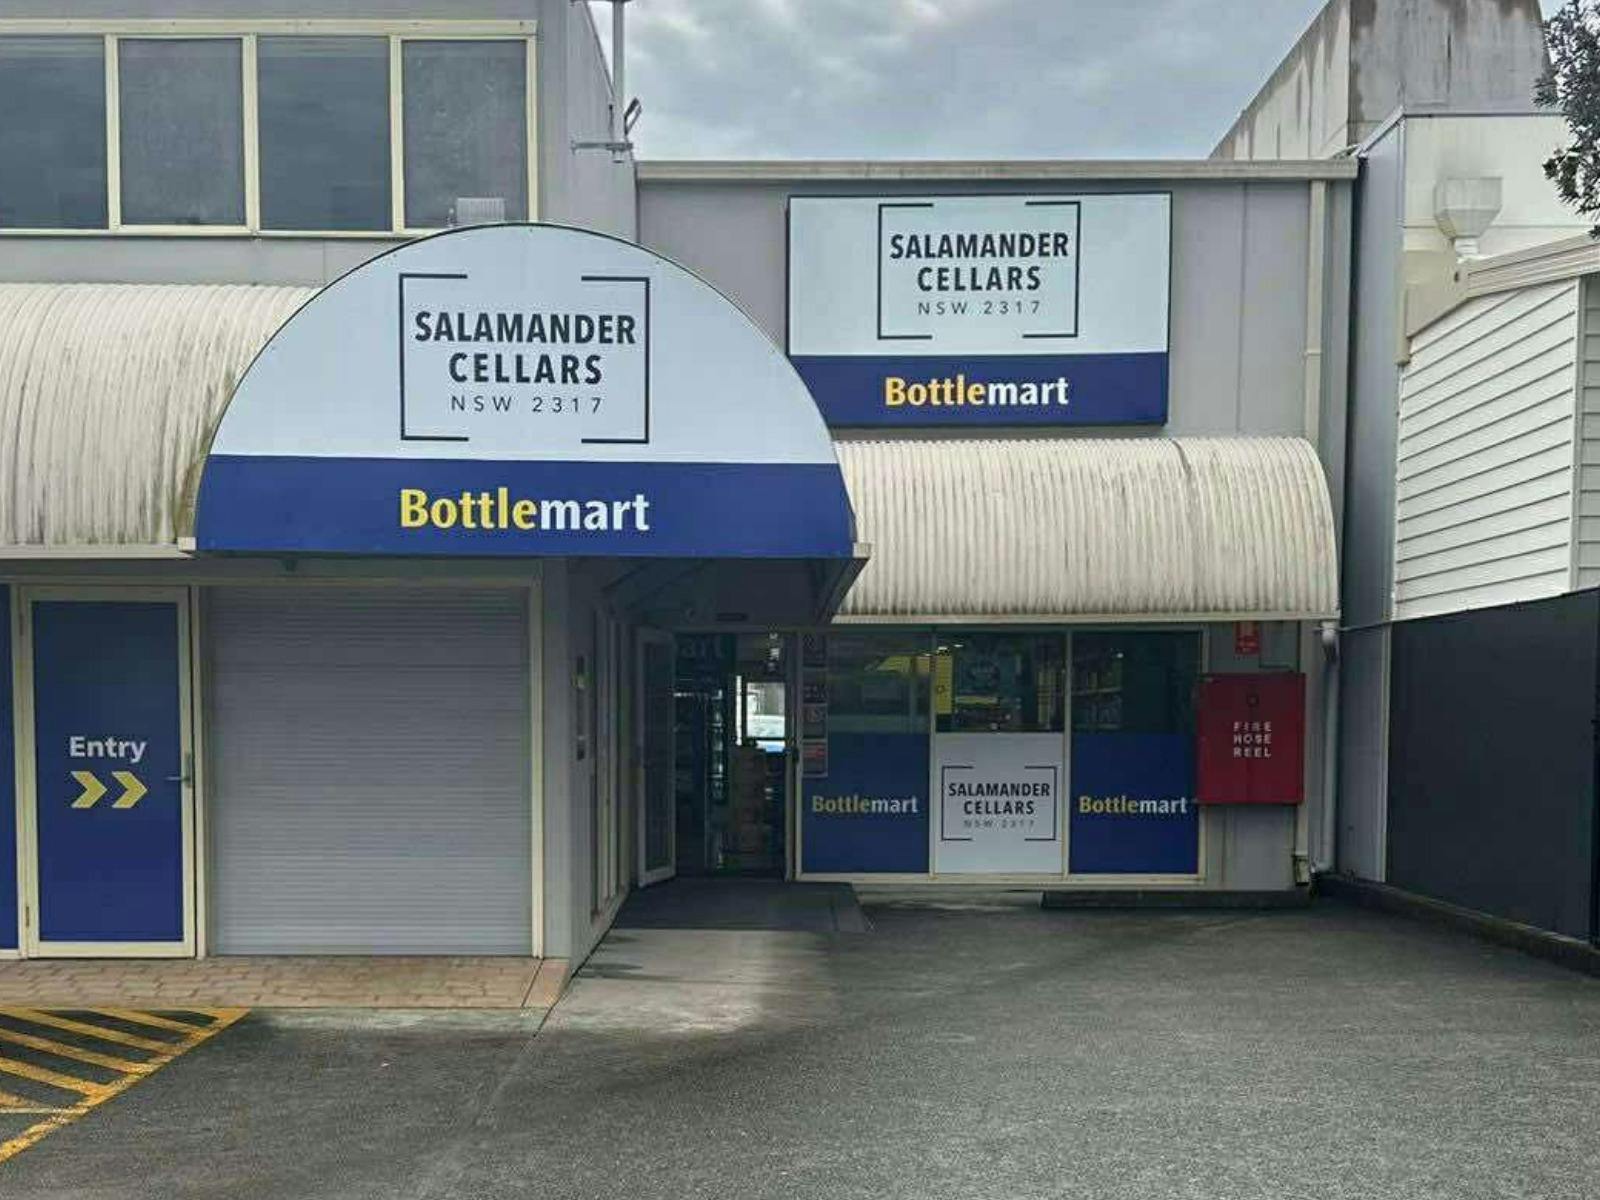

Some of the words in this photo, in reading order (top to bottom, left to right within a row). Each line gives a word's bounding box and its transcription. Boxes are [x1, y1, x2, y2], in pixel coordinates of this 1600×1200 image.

[890, 232, 1069, 259] SALAMANDER
[917, 266, 1041, 292] CELLARS
[918, 301, 969, 315] NSW
[984, 300, 1041, 315] 2317
[415, 311, 636, 345] SALAMANDER
[448, 352, 603, 386] CELLARS
[884, 374, 1069, 406] Bottlemart
[451, 395, 513, 413] NSW
[532, 396, 603, 414] 2317
[400, 487, 651, 532] Bottlemart
[1233, 721, 1272, 732] FIRE
[1233, 734, 1272, 745] HOSE
[69, 736, 148, 764] Entry
[1233, 747, 1272, 758] REEL
[948, 783, 1050, 797] SALAMANDER
[812, 795, 918, 814] Bottlemart
[964, 800, 1035, 815] CELLARS
[1079, 795, 1188, 814] Bottlemart
[963, 820, 993, 828] NSW
